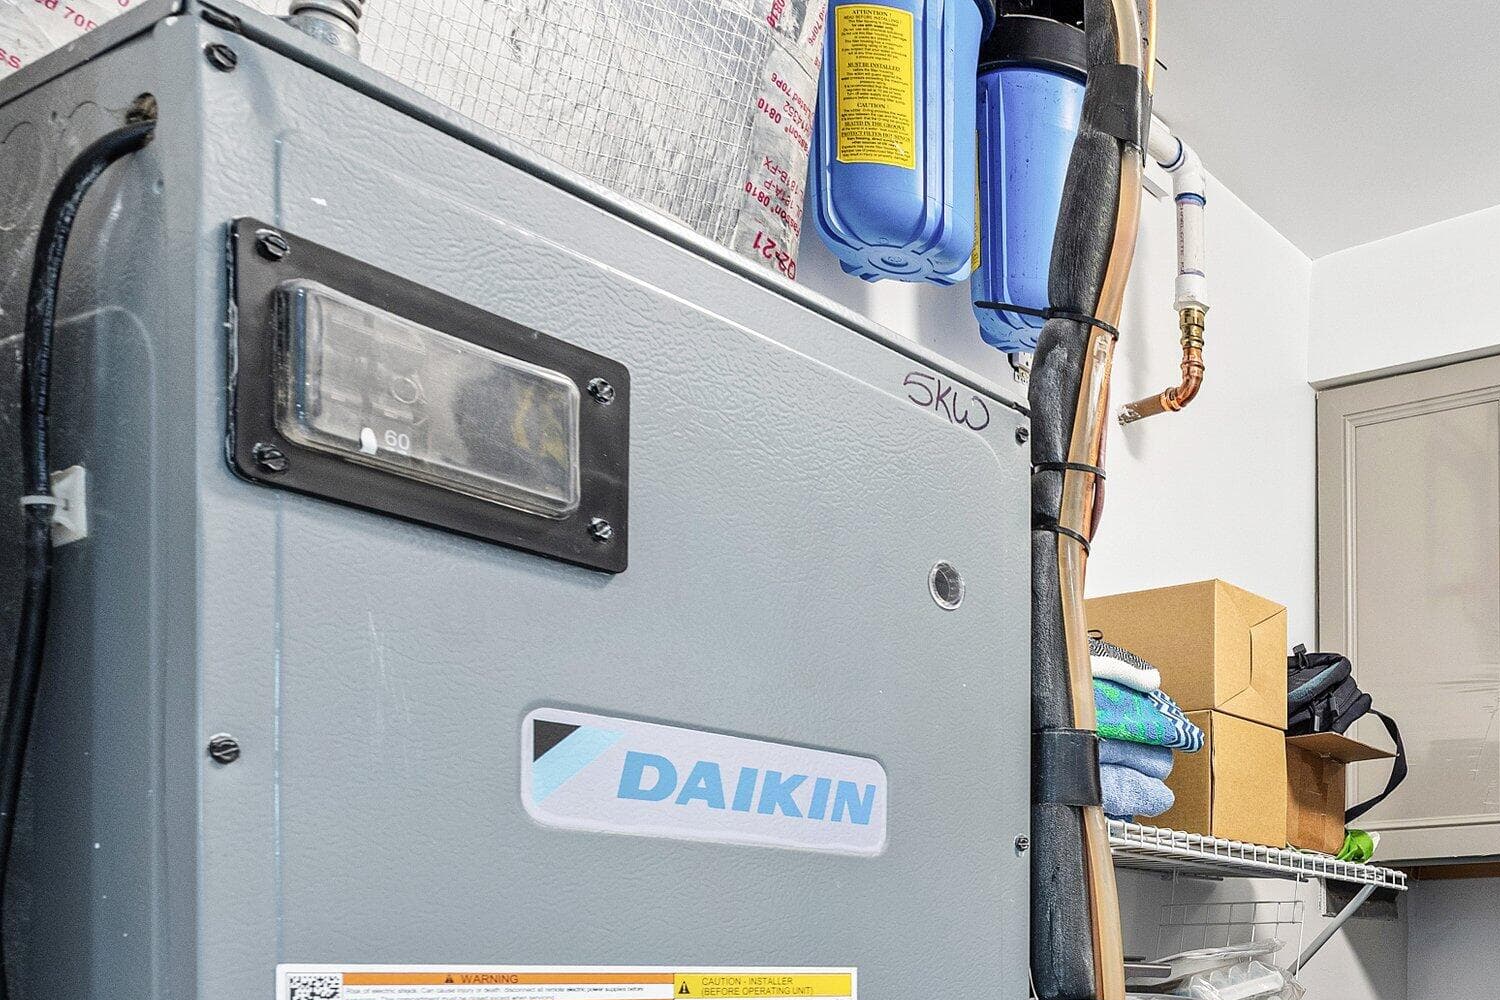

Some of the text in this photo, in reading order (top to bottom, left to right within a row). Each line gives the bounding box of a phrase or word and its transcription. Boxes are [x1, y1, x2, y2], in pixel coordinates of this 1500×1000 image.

[757, 98, 782, 124] 0810
[745, 182, 771, 207] 0810
[384, 429, 410, 451] 60
[617, 750, 876, 826] DAIKIN
[460, 974, 518, 983] WARNING
[701, 977, 792, 985] CAUTION INSTALLER
[701, 986, 813, 996] (BEFORE OPERATING UNIT)
